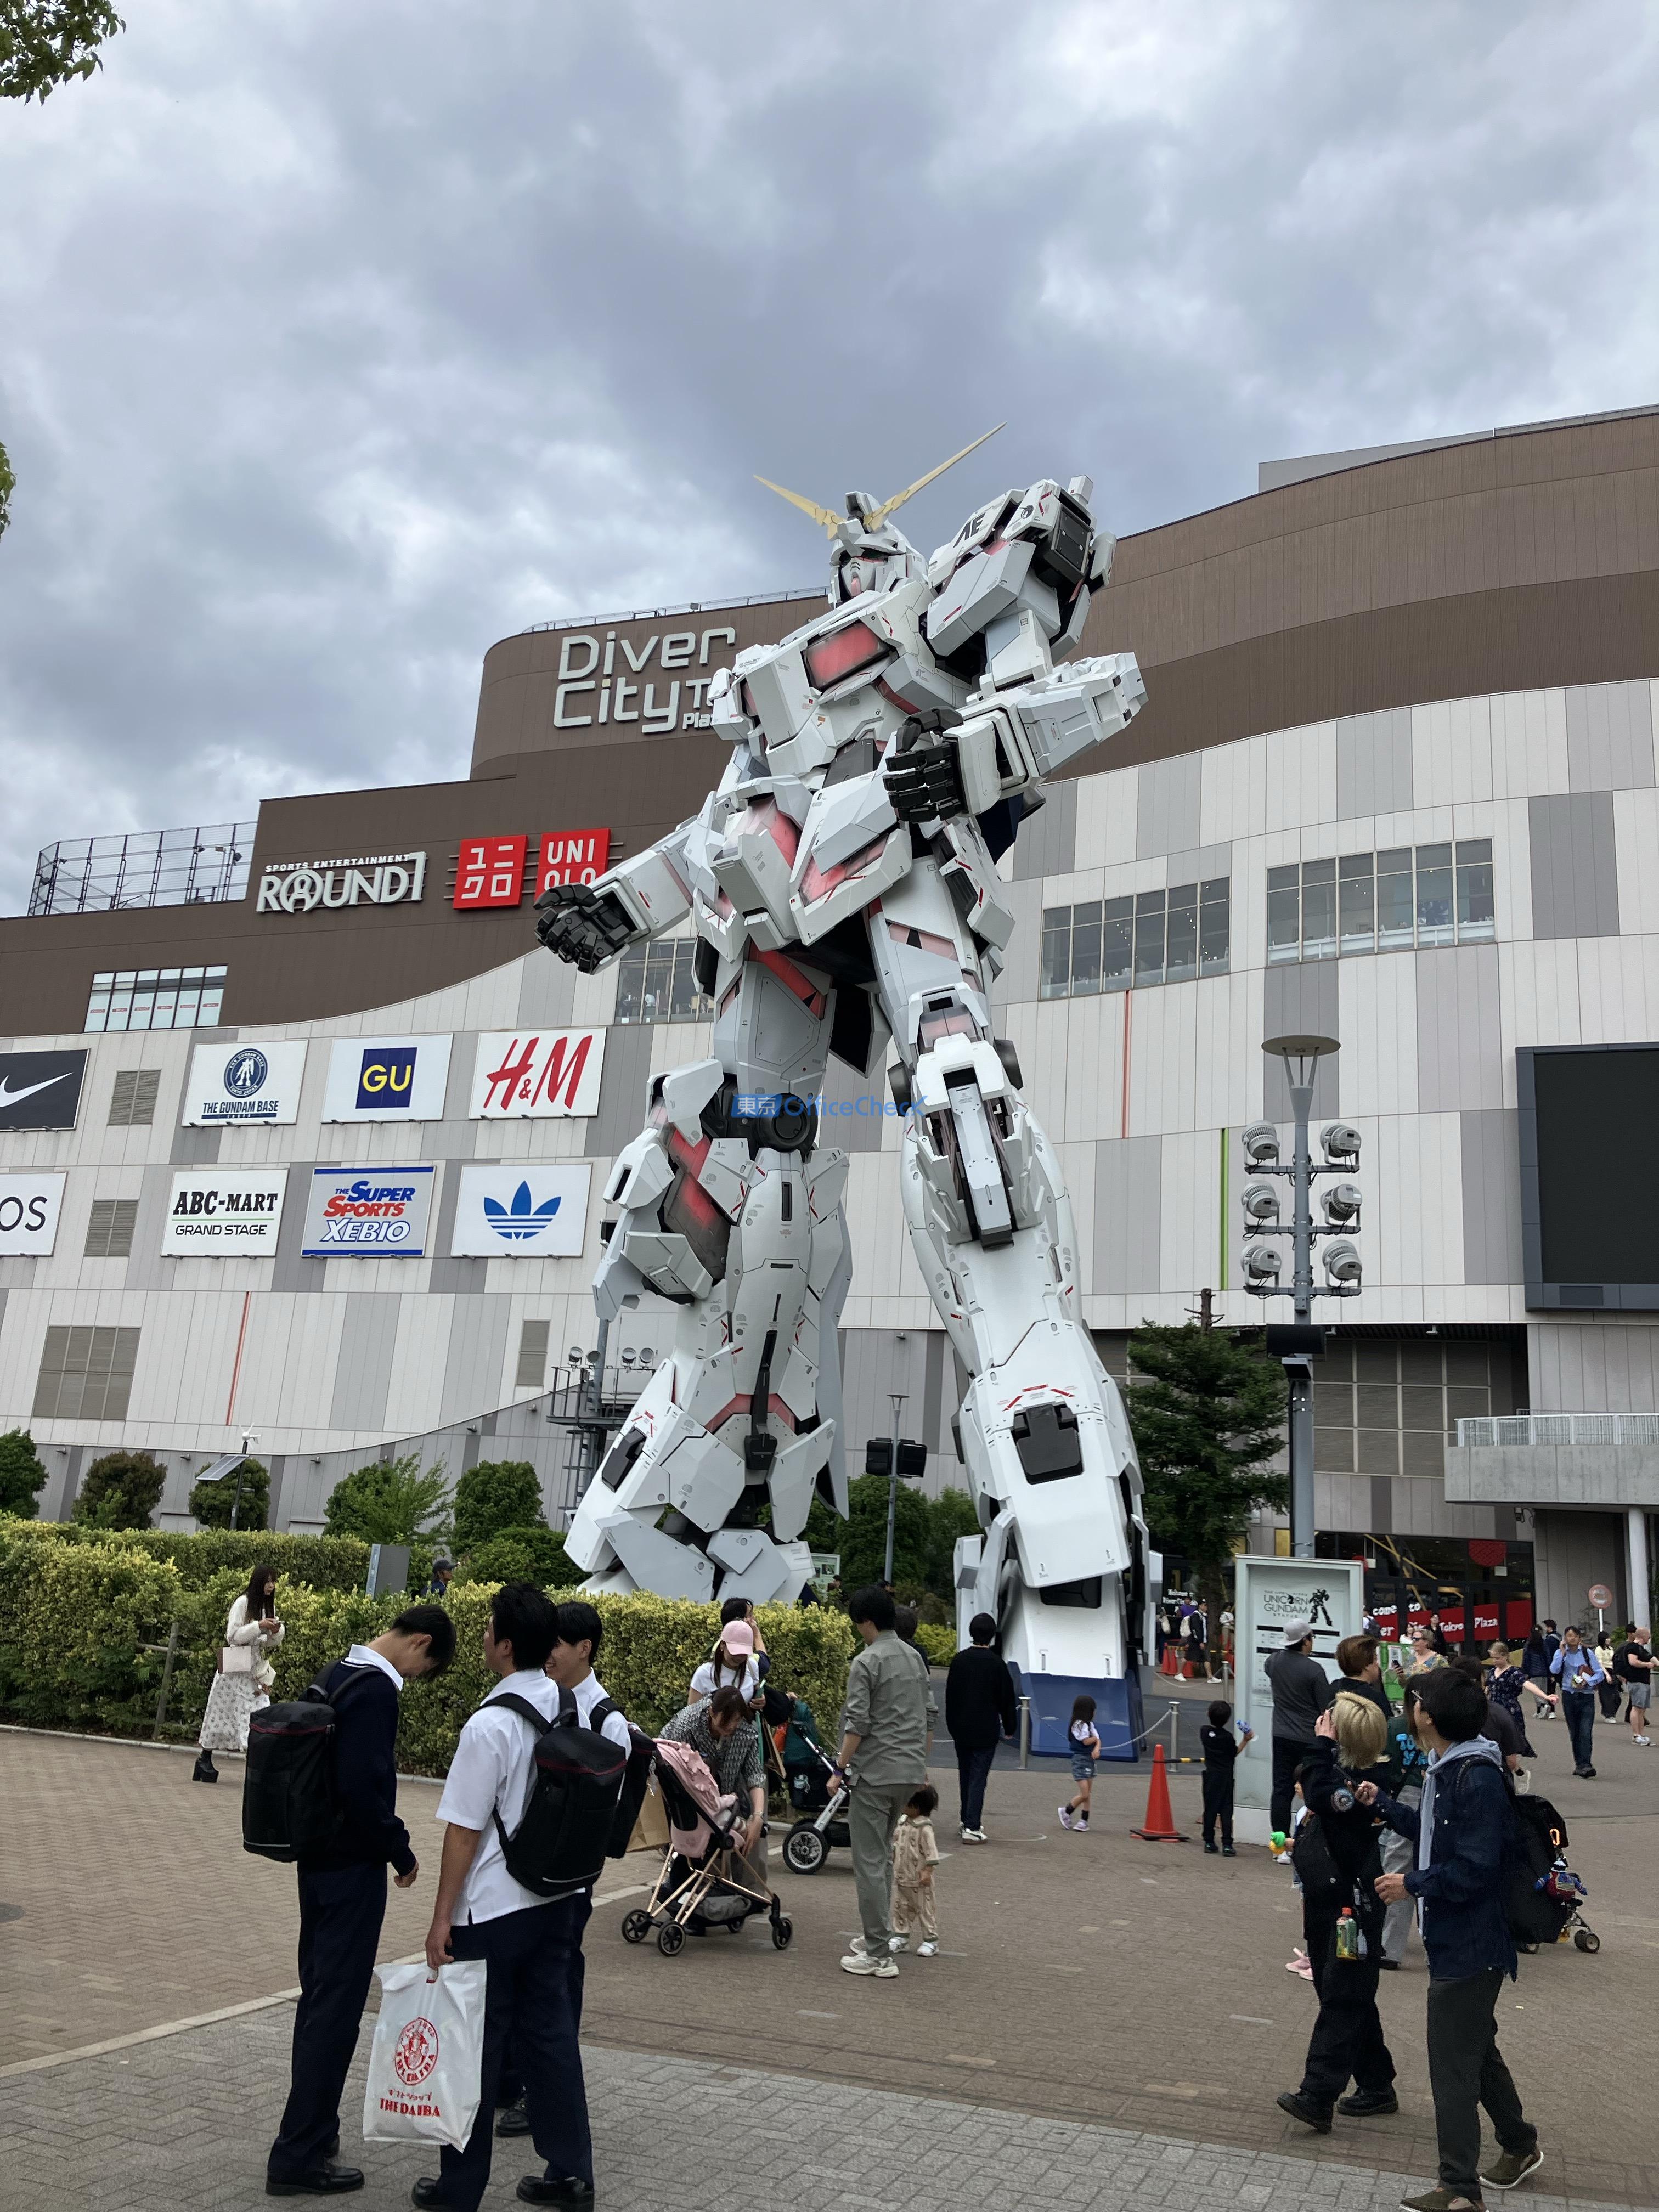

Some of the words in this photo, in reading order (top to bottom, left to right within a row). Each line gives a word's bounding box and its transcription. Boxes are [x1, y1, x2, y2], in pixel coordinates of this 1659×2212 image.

[558, 627, 736, 680] Diver
[554, 677, 680, 733] City
[686, 678, 714, 709] T
[265, 862, 309, 872] SPORTS
[313, 854, 410, 868] ENTERTAINMENT
[466, 845, 514, 870] ユニ
[548, 838, 595, 865] UNI
[256, 851, 426, 913] ROUND1
[461, 873, 512, 899] クロ
[363, 1064, 411, 1092] GU
[483, 1035, 593, 1110] H&M
[203, 1102, 218, 1114] THE
[219, 1101, 255, 1113] GUNDAM
[257, 1100, 279, 1112] BASE
[173, 1190, 278, 1215] ABC-MART
[347, 1181, 416, 1202] SUPER
[323, 1195, 405, 1217] SPORTS
[176, 1224, 222, 1235] GRAND
[224, 1224, 268, 1235] STAGE
[319, 1217, 410, 1243] XEBIO
[1263, 1594, 1308, 1605] UNICORN
[1263, 1603, 1308, 1613] GUNDAM
[1408, 1602, 1421, 1612] to
[1439, 1621, 1464, 1632] Tokyo
[1474, 1617, 1499, 1628] Plaza
[380, 2097, 399, 2113] THE
[400, 2103, 441, 2117] DAIBA
